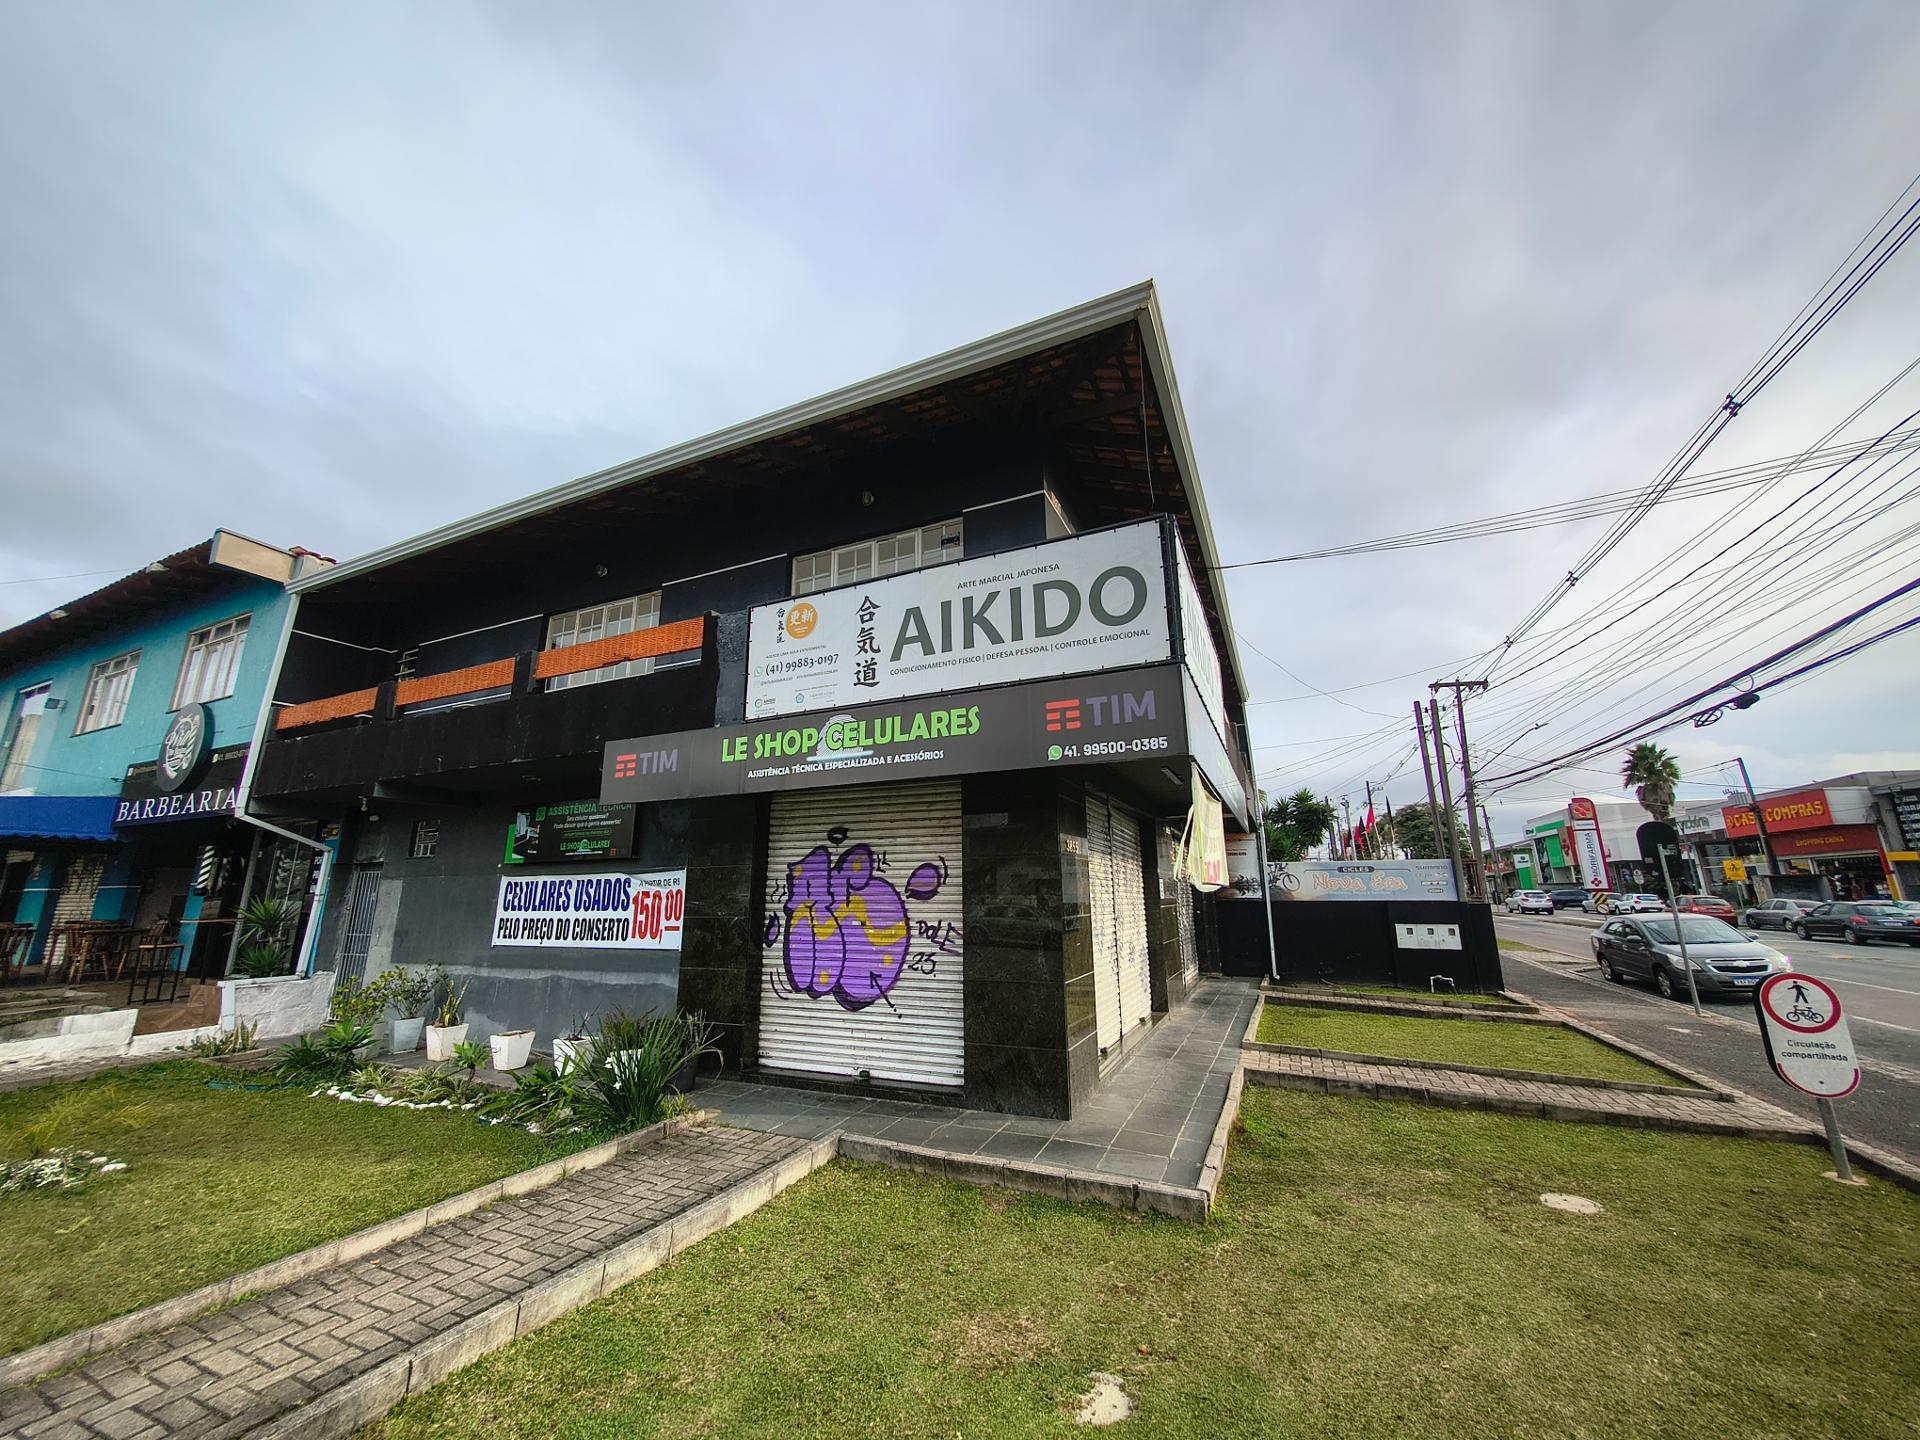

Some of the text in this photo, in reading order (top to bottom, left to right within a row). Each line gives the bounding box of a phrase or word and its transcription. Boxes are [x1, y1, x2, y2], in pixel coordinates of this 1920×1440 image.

[957, 563, 1060, 589] ARTE MARCIAL JAPONESA
[889, 566, 1148, 662] AIKIDO
[853, 596, 881, 687] 合気道
[889, 628, 1150, 676] CONDICIONAMENTO FÍSICO DEFESA PESSOAL CONTROLE EMOCIONAL
[765, 653, 839, 676] (41) 99883-0197
[1086, 690, 1157, 726] TIM
[721, 705, 980, 762] LE SHOP CELULARES
[1083, 737, 1168, 756] 99500-0385
[640, 749, 679, 775] TIM
[791, 763, 824, 775] TÉCNICA
[824, 755, 885, 770] ESPECIALIZADA
[886, 756, 892, 764] E
[893, 750, 944, 763] ACESSÓRIOS
[115, 787, 237, 822] BARBEARIA
[547, 803, 597, 816] ASSISTÊNCIA
[1766, 801, 1824, 822] COMPRAS
[663, 878, 671, 887] DE
[1312, 872, 1366, 890] Nova
[503, 877, 632, 912] CELULARES USADOS
[497, 917, 630, 944] PELO PREÇO DO CONSERTO
[1781, 1051, 1848, 1062] compartilhada
[1787, 1040, 1836, 1050] Circulação
